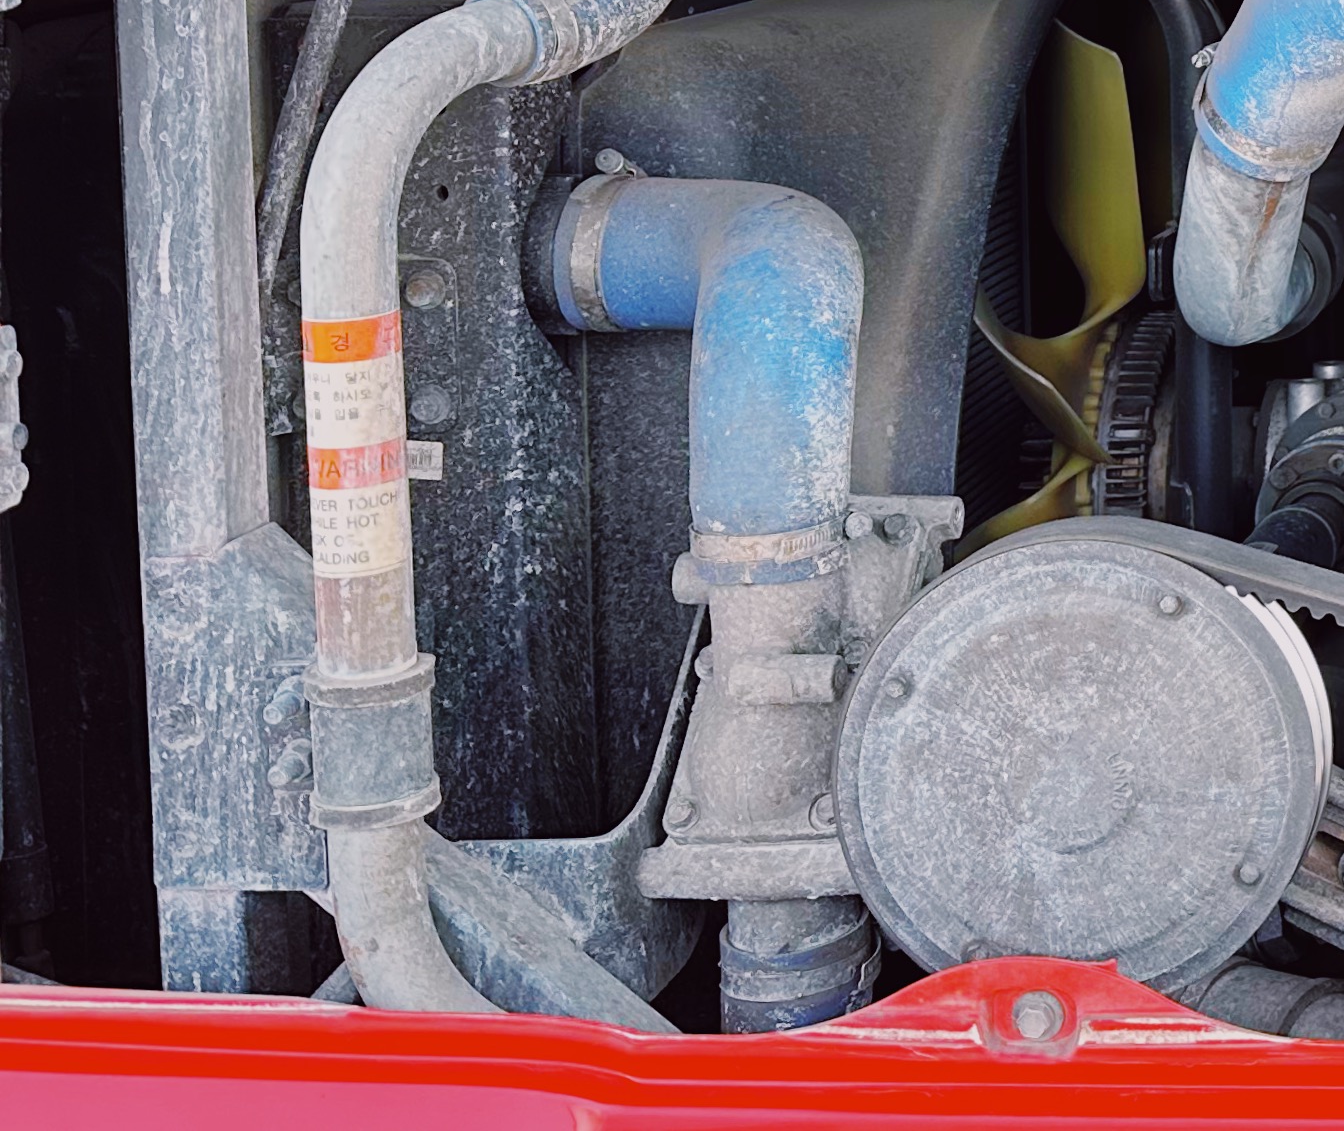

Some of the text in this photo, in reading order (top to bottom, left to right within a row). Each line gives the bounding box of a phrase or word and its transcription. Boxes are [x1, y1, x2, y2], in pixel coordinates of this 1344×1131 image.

[330, 332, 349, 352] 경
[333, 389, 371, 404] 하시오
[348, 492, 398, 511] TOUCH
[346, 513, 380, 528] HOT
